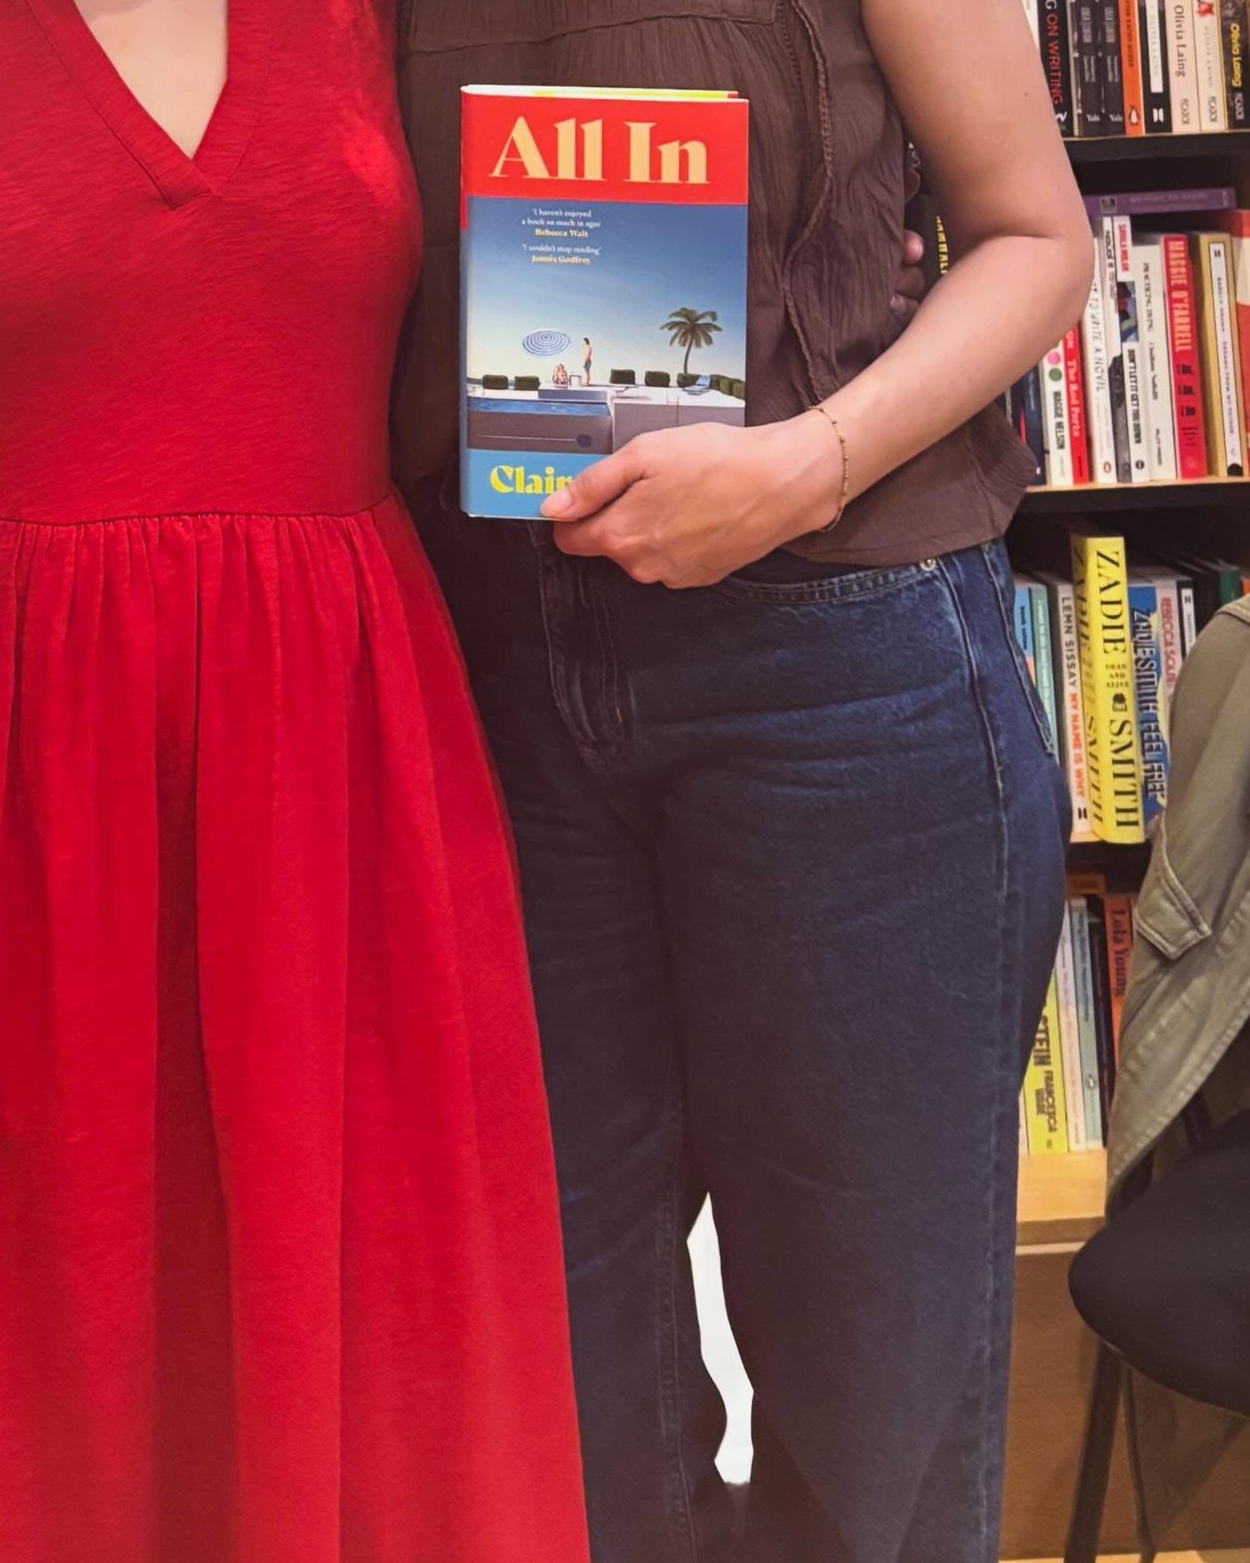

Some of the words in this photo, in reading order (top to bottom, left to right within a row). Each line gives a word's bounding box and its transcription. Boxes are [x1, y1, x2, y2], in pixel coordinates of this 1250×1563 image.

[1047, 13, 1059, 36] ON
[1175, 5, 1186, 41] Olivia
[1230, 24, 1240, 53] Olivia
[1048, 41, 1062, 105] WRITING
[1175, 44, 1187, 78] Laing
[1232, 57, 1243, 87] Laing
[488, 116, 605, 182] All
[624, 120, 709, 184] In
[1168, 241, 1187, 286] MAGGIE
[490, 466, 572, 494] Clair
[1062, 597, 1074, 634] LEMN
[1096, 550, 1126, 655] ZADIE
[1133, 611, 1153, 659] ZADIE
[1065, 640, 1076, 687] SISSAY
[1070, 693, 1079, 711] MY
[1135, 660, 1157, 713] SMITH
[1071, 714, 1081, 750] NAME
[1142, 722, 1162, 758] FEEL
[1074, 754, 1083, 765] IS
[1109, 719, 1139, 828] SMITH
[1075, 769, 1085, 797] WHY
[1145, 764, 1165, 798] FREE
[1111, 910, 1127, 943] Lola
[1115, 949, 1129, 998] Young
[1045, 1070, 1057, 1132] FRANCESCA
